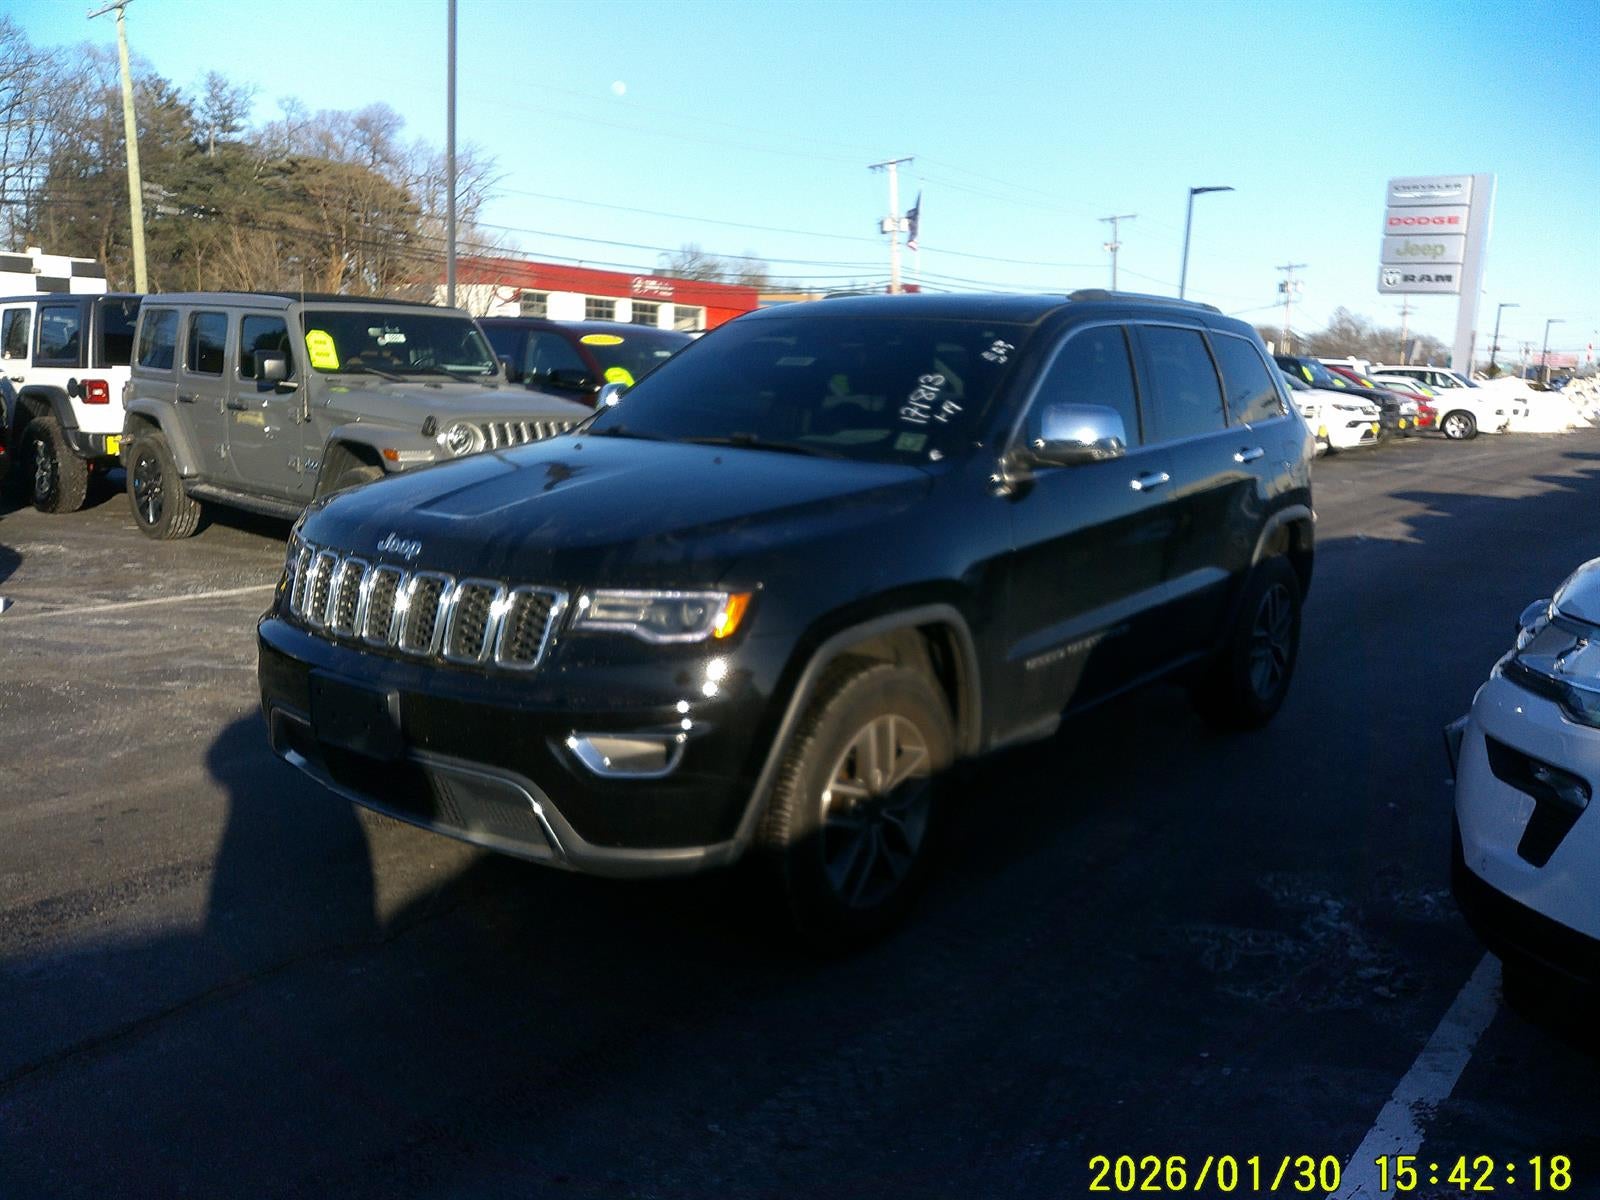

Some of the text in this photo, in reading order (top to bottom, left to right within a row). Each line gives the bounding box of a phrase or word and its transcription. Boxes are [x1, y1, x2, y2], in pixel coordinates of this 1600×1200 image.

[1388, 216, 1459, 226] DODGE
[1395, 240, 1446, 260] Jeep
[1402, 274, 1454, 283] RAM
[377, 532, 422, 560] Jeep
